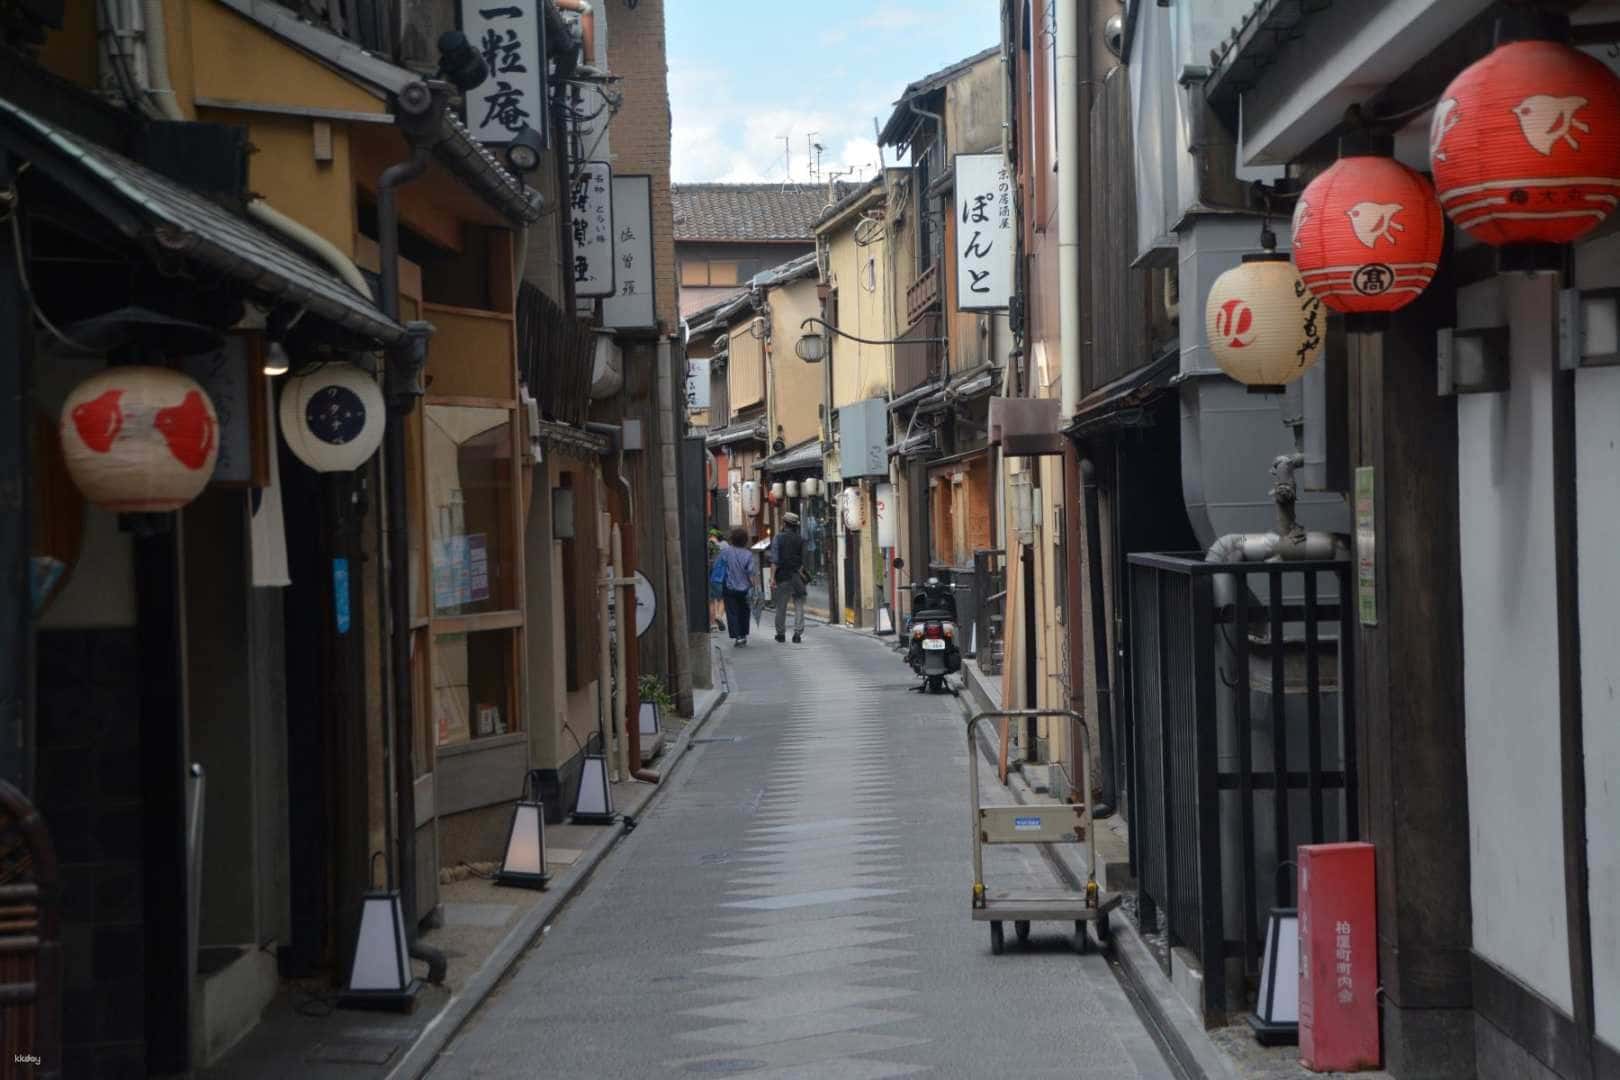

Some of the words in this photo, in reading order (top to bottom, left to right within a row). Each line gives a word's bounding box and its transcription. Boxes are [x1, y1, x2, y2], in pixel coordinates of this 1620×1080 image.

[478, 5, 531, 132] 一粒庵
[962, 192, 994, 293] ぽんと
